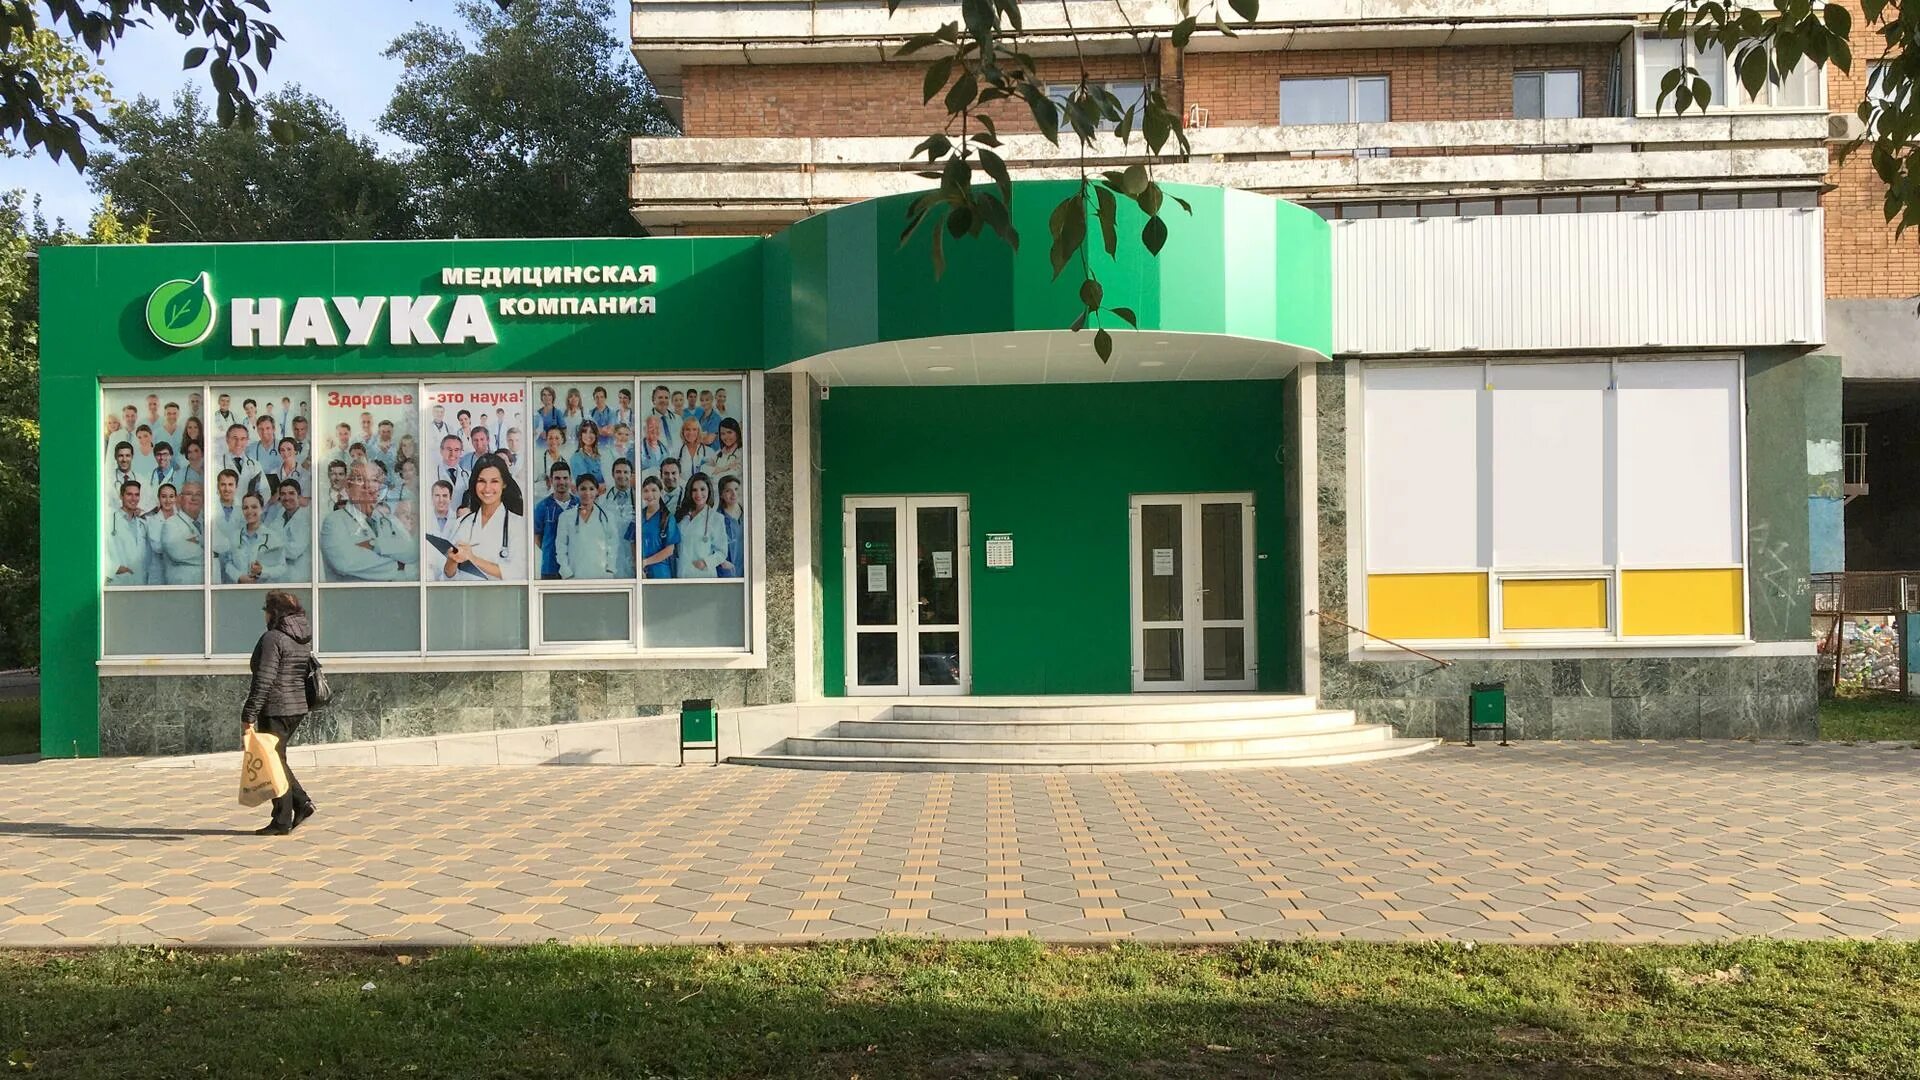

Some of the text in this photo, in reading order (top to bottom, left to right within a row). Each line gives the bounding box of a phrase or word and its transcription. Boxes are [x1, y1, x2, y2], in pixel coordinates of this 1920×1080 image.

[442, 265, 657, 288] МЕДИЦИНСКАЯ
[500, 296, 657, 316] КОМПАНИЯ
[231, 294, 499, 347] НАУКА
[328, 391, 413, 408] Здоровье
[470, 389, 524, 405] наука!
